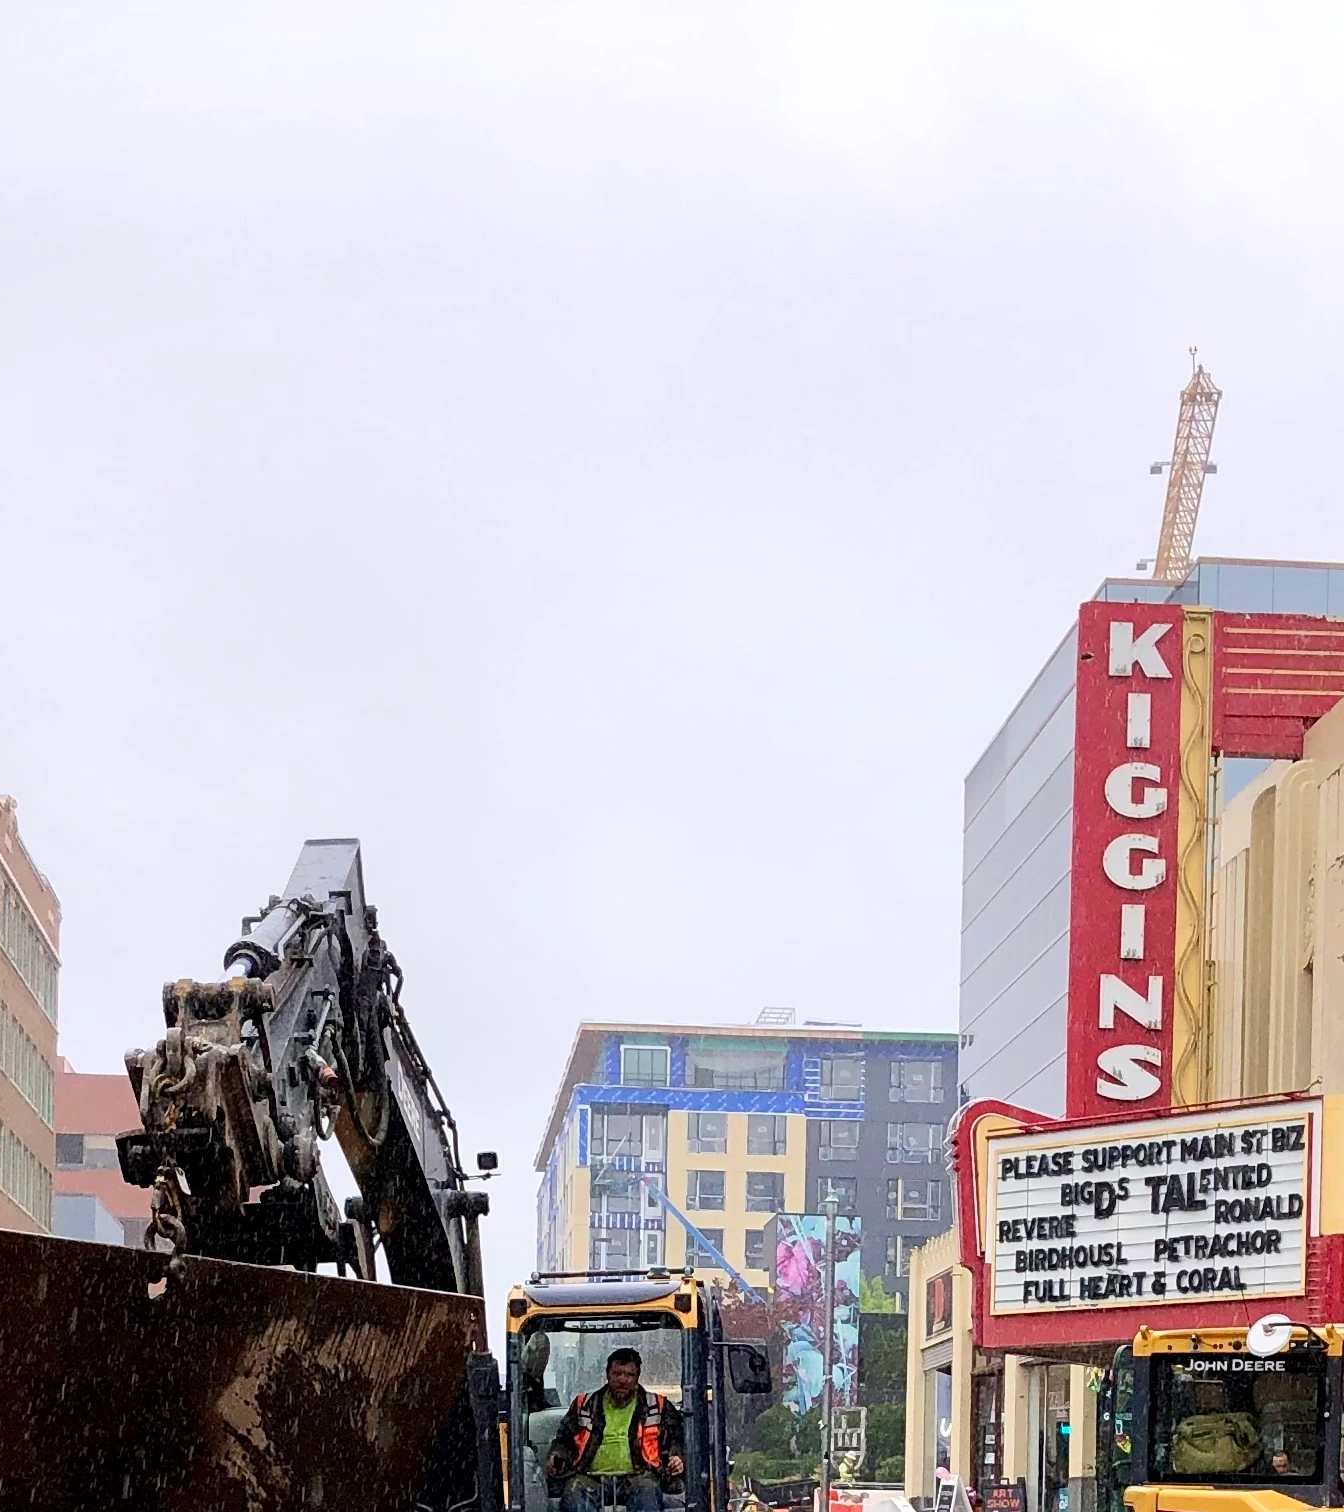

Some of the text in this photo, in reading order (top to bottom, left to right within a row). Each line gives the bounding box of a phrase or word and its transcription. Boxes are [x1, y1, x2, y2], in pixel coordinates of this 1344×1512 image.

[1096, 620, 1174, 1101] KIGGINS
[1000, 1124, 1305, 1181] PLEASE SUPPORT MAIN ST BIZ
[1144, 1163, 1273, 1215] TALENTED
[999, 1193, 1304, 1244] REVERIE RONALD
[1154, 1229, 1282, 1263] PETRACHOR
[1023, 1266, 1247, 1303] FULL HEART & CORAL
[1184, 1358, 1286, 1372] JOHN DEERE
[987, 1498, 1020, 1509] SHOW
[991, 1488, 1014, 1499] ART
